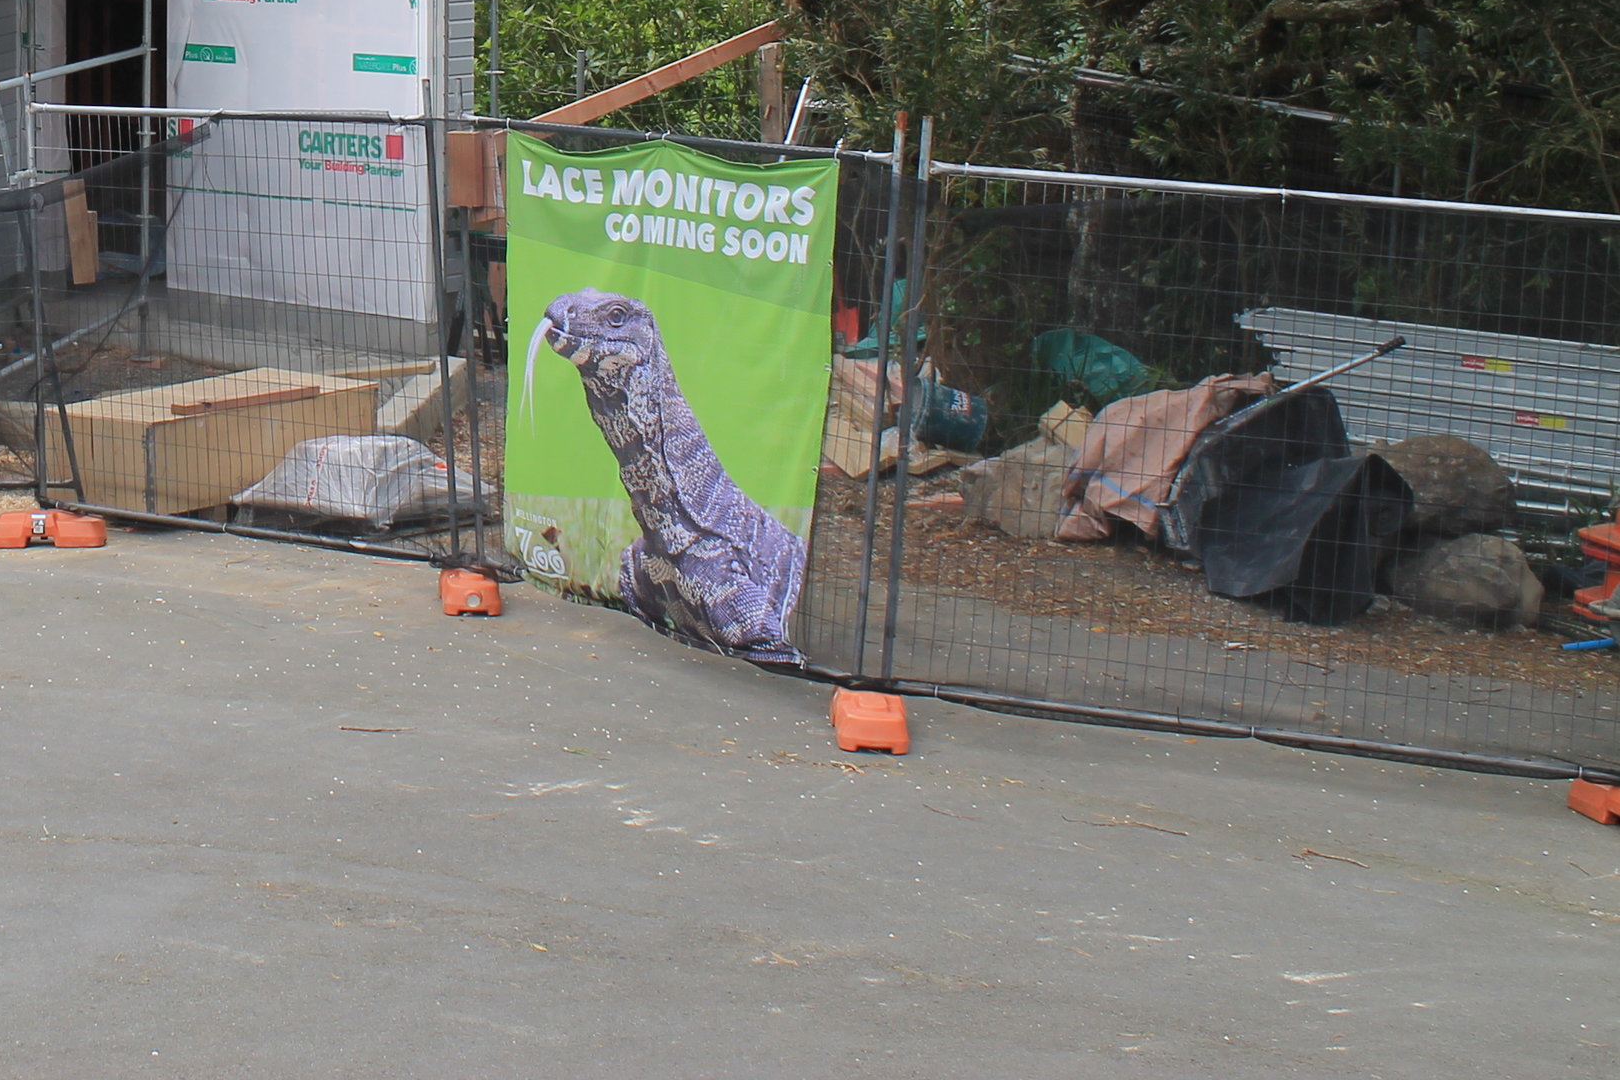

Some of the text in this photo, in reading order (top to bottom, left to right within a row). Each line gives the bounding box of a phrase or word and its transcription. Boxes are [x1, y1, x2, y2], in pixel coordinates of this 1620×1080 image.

[299, 130, 383, 159] CARTERS
[299, 158, 404, 177] Your Building Partner
[521, 159, 816, 227] LACE MONITORS
[604, 212, 810, 265] COMING SOON
